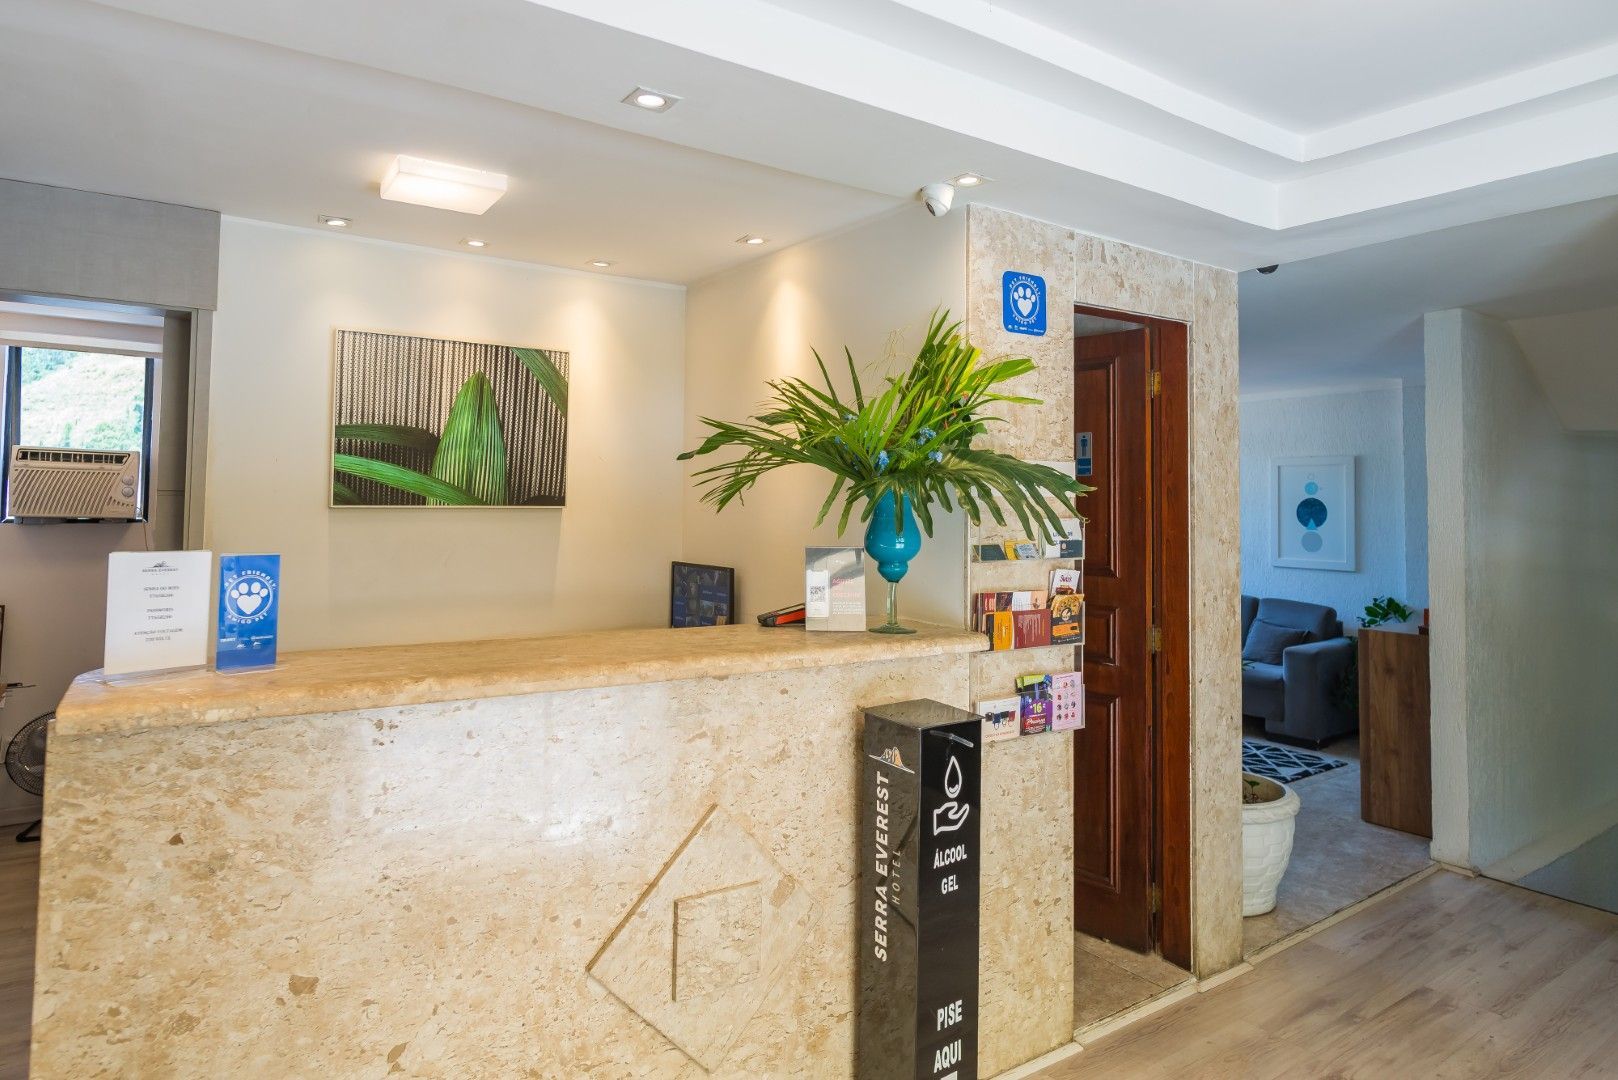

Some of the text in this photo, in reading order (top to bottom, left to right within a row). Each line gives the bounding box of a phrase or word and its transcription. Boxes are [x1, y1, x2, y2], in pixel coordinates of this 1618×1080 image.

[224, 569, 276, 590] PET FRIENDLY
[227, 612, 268, 624] AMIGO PET
[874, 770, 889, 962] SERRA EVEREST
[933, 843, 968, 870] ÁLCOOL
[891, 850, 901, 905] HOTEL
[941, 874, 959, 895] GEL
[937, 999, 963, 1032] PISE
[933, 1038, 962, 1074] AQUI
